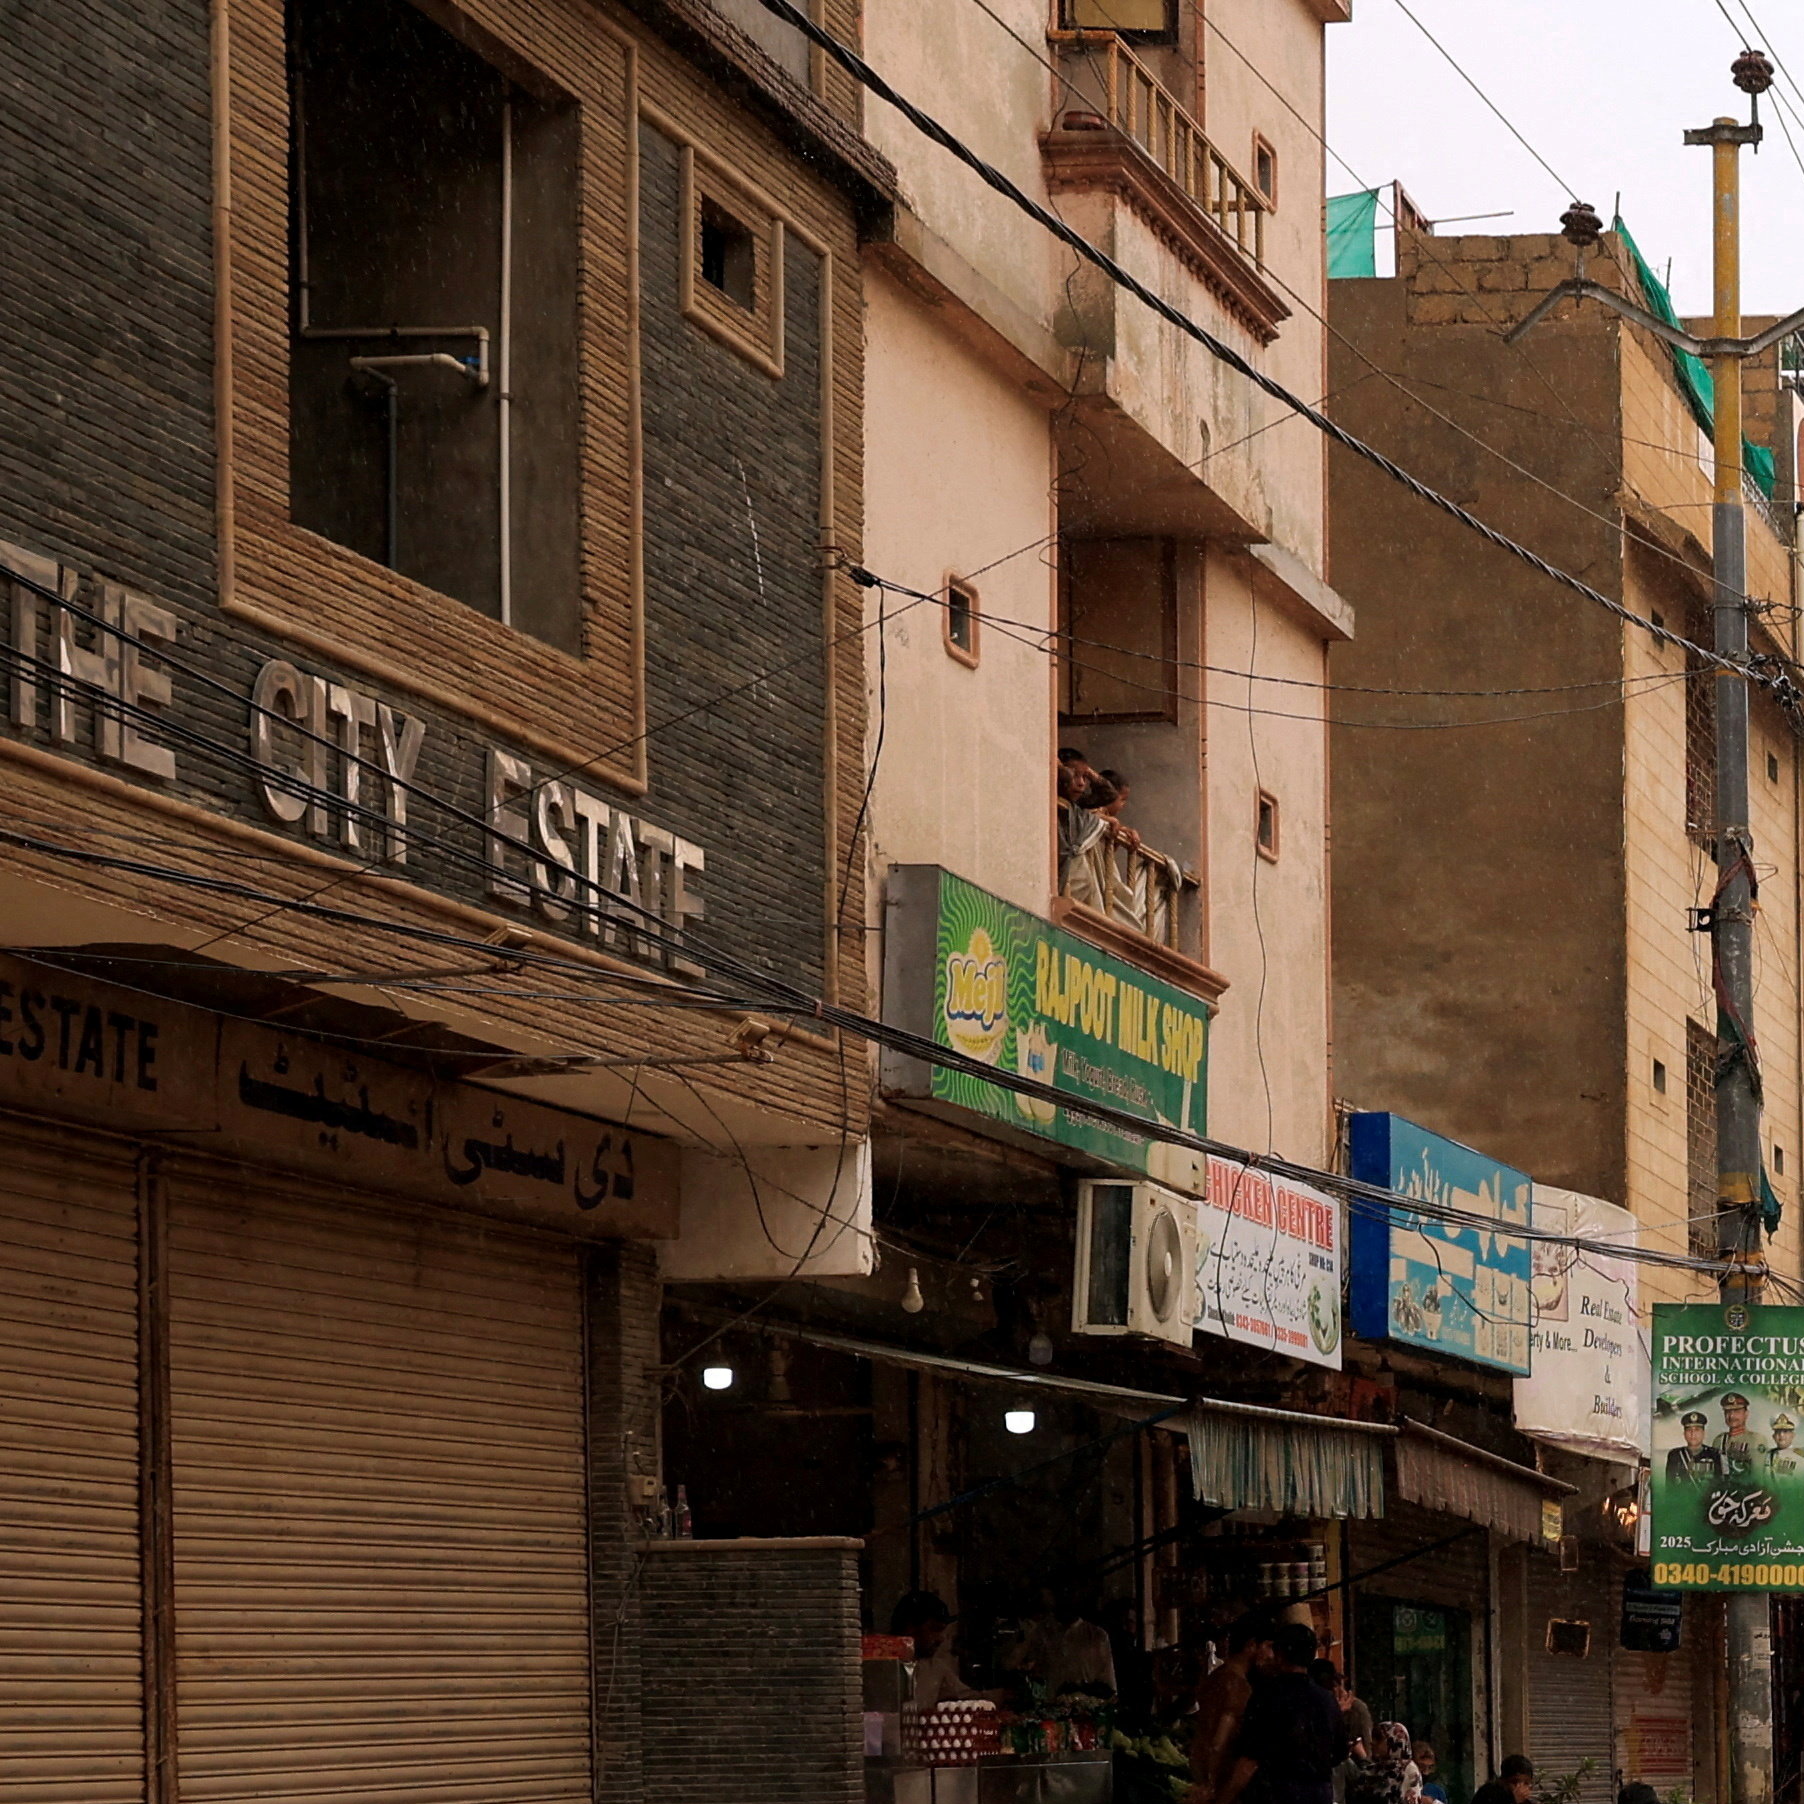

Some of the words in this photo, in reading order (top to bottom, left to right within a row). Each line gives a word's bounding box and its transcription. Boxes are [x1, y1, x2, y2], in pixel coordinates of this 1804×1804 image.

[0, 541, 176, 780] THE
[250, 657, 427, 865] CITY
[484, 749, 705, 979] ESTATE
[1036, 940, 1116, 1045] RAJPOOT
[1118, 980, 1160, 1066] MILK
[1162, 1002, 1204, 1084] SHOP
[0, 980, 158, 1091] ESTATE
[239, 1042, 438, 1154] اسٹیٹ
[443, 1108, 565, 1186] سٹی
[574, 1135, 635, 1210] دی
[1276, 1185, 1334, 1252] CENTRE
[1580, 1295, 1602, 1319] Real
[1545, 1330, 1551, 1348] &
[1583, 1328, 1622, 1359] Developers
[1604, 1365, 1611, 1384] &
[1660, 1372, 1721, 1385] SCHOOL
[1724, 1373, 1735, 1384] &
[1593, 1394, 1622, 1420] Builders
[1660, 1537, 1691, 1548] 2025
[1692, 1538, 1738, 1556] مبارک
[1738, 1537, 1772, 1556] آزادی
